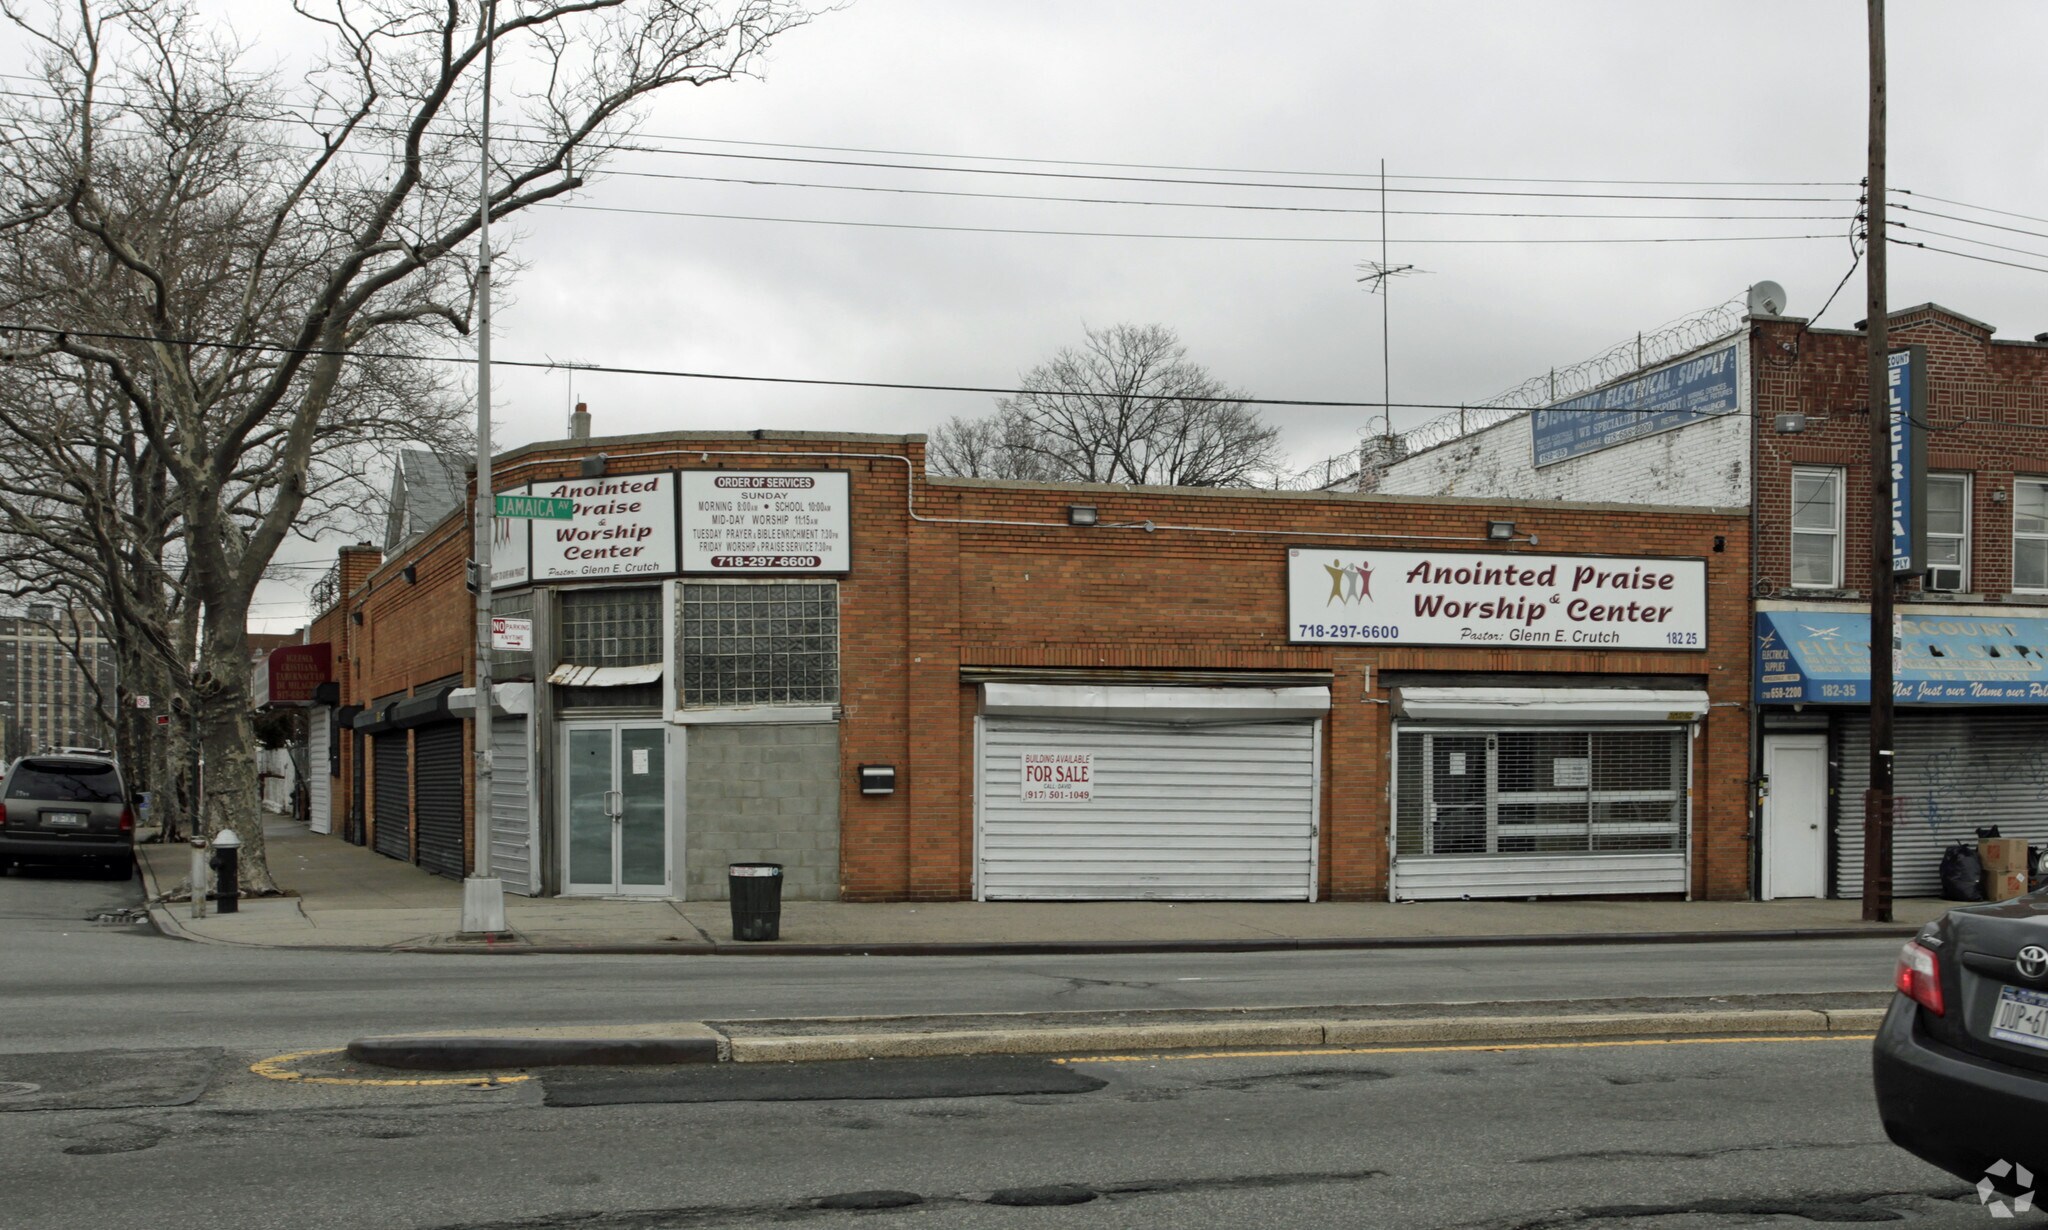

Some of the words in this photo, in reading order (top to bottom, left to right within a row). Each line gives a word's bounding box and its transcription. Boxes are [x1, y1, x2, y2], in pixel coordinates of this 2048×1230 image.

[1605, 369, 1672, 409] ELECTRICAL
[1677, 351, 1729, 386] SUPPLY
[551, 477, 659, 498] Anointed
[718, 477, 750, 488] ORDER
[752, 478, 765, 487] OF
[766, 478, 812, 488] SERVICES
[498, 498, 555, 517] JAMAICA
[558, 500, 570, 510] AV
[698, 502, 733, 512] MORNING
[775, 502, 805, 512] SCHOOL
[712, 515, 745, 525] MID-DAY
[752, 515, 789, 525] WORSHIP
[556, 522, 653, 542] Worship
[693, 529, 722, 539] TUESDAY
[726, 529, 753, 539] PRAYER
[757, 529, 775, 539] BIBLE
[777, 529, 818, 539] ENRICHMENT
[563, 545, 645, 561] Center
[699, 542, 722, 552] FRIDAY
[726, 542, 756, 552] WORSHIP
[761, 542, 785, 552] PRAISE
[785, 542, 814, 552] SERVICE
[718, 556, 815, 567] 718-297-6600
[548, 567, 578, 577] Pastor:
[581, 564, 610, 575] Glenn
[613, 563, 622, 573] E.
[625, 561, 659, 573] Crutch
[1406, 560, 1557, 587] Anointed
[1572, 565, 1675, 592] Praise
[1414, 594, 1547, 627] Worship
[1549, 593, 1561, 605] &
[1566, 598, 1674, 623] Center
[494, 621, 504, 632] NO
[1299, 624, 1399, 639] 718-297-6600
[1460, 627, 1504, 641] Pastor:
[1509, 628, 1550, 642] Glenn
[1555, 629, 1567, 642] E.
[1572, 629, 1620, 643] Crutch
[1902, 620, 2018, 637] SCOUNT
[1762, 650, 1789, 660] ELECTRICAL
[1764, 662, 1786, 672] SUPPLIES
[1822, 684, 1857, 697] 182-35
[1917, 680, 1943, 700] Just
[1946, 686, 1967, 696] our
[1970, 681, 2004, 697] Name
[2006, 686, 2026, 697] our
[1025, 754, 1054, 763] BUILDING
[1056, 754, 1090, 764] AVAILABLE
[1026, 765, 1053, 782] FOR
[1056, 765, 1090, 782] SALE
[1025, 790, 1047, 799] (917)
[1049, 790, 1090, 799] 501-1049
